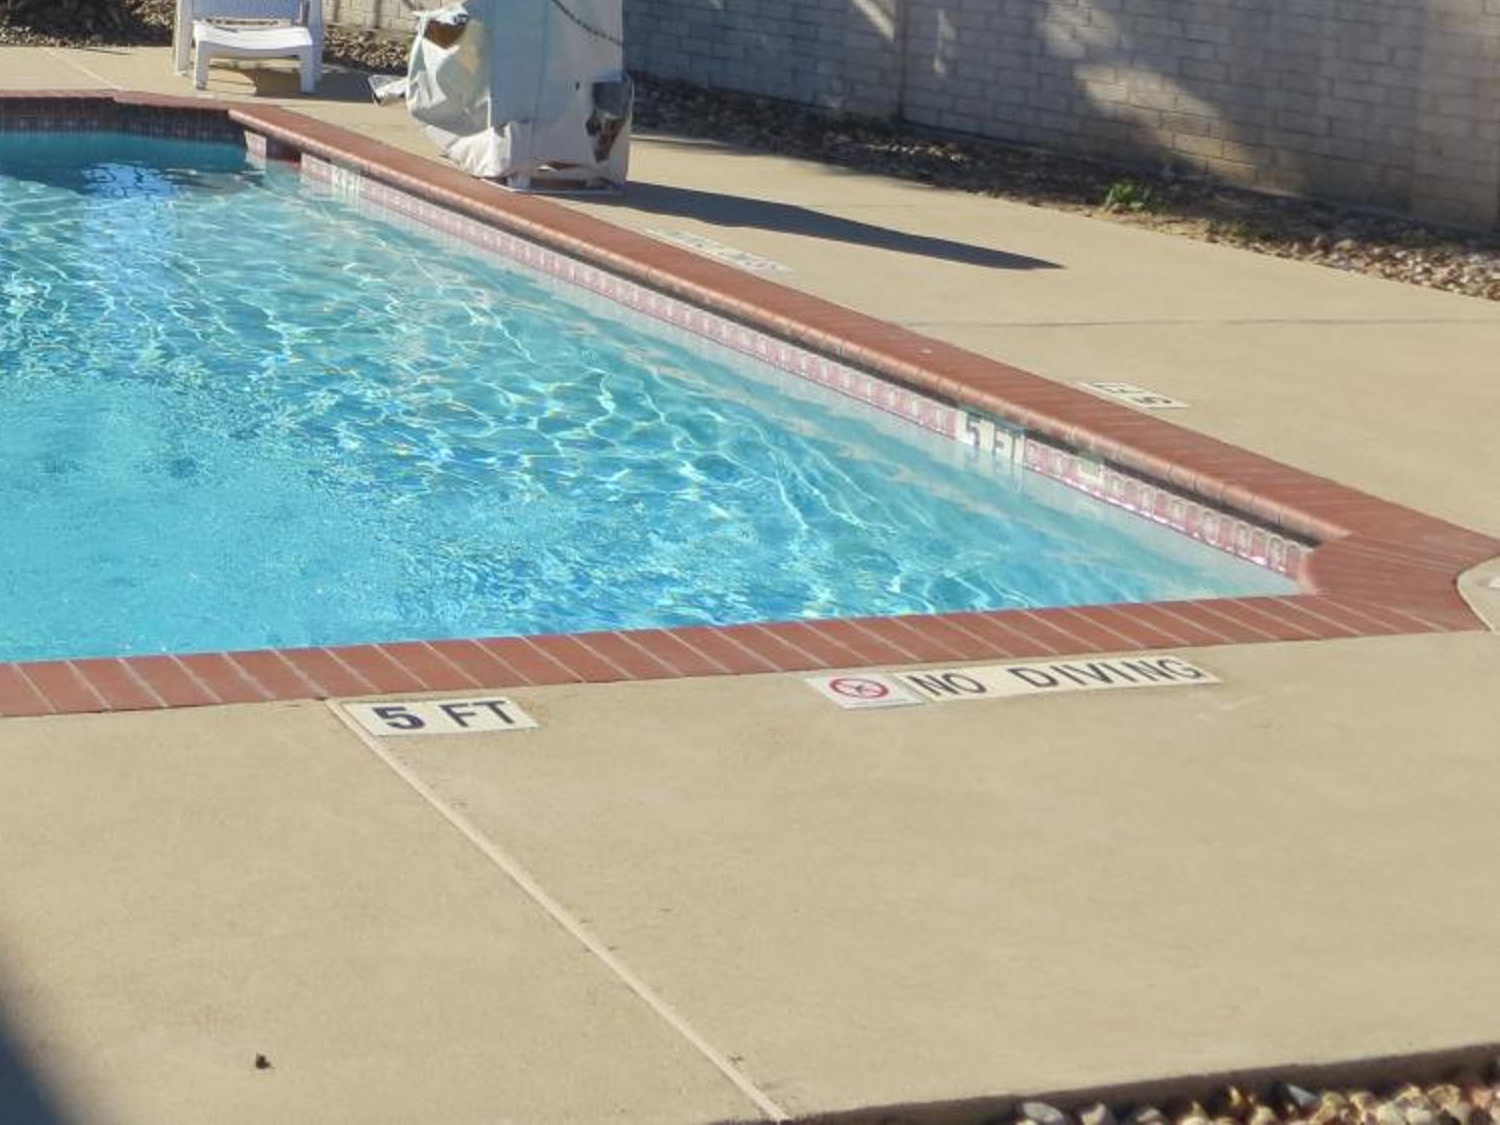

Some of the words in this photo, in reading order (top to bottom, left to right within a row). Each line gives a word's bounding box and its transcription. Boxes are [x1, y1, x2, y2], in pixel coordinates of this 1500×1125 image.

[908, 672, 988, 697] NO
[1007, 657, 1202, 689] DIVING
[372, 706, 426, 730] 5
[439, 700, 516, 727] FT
